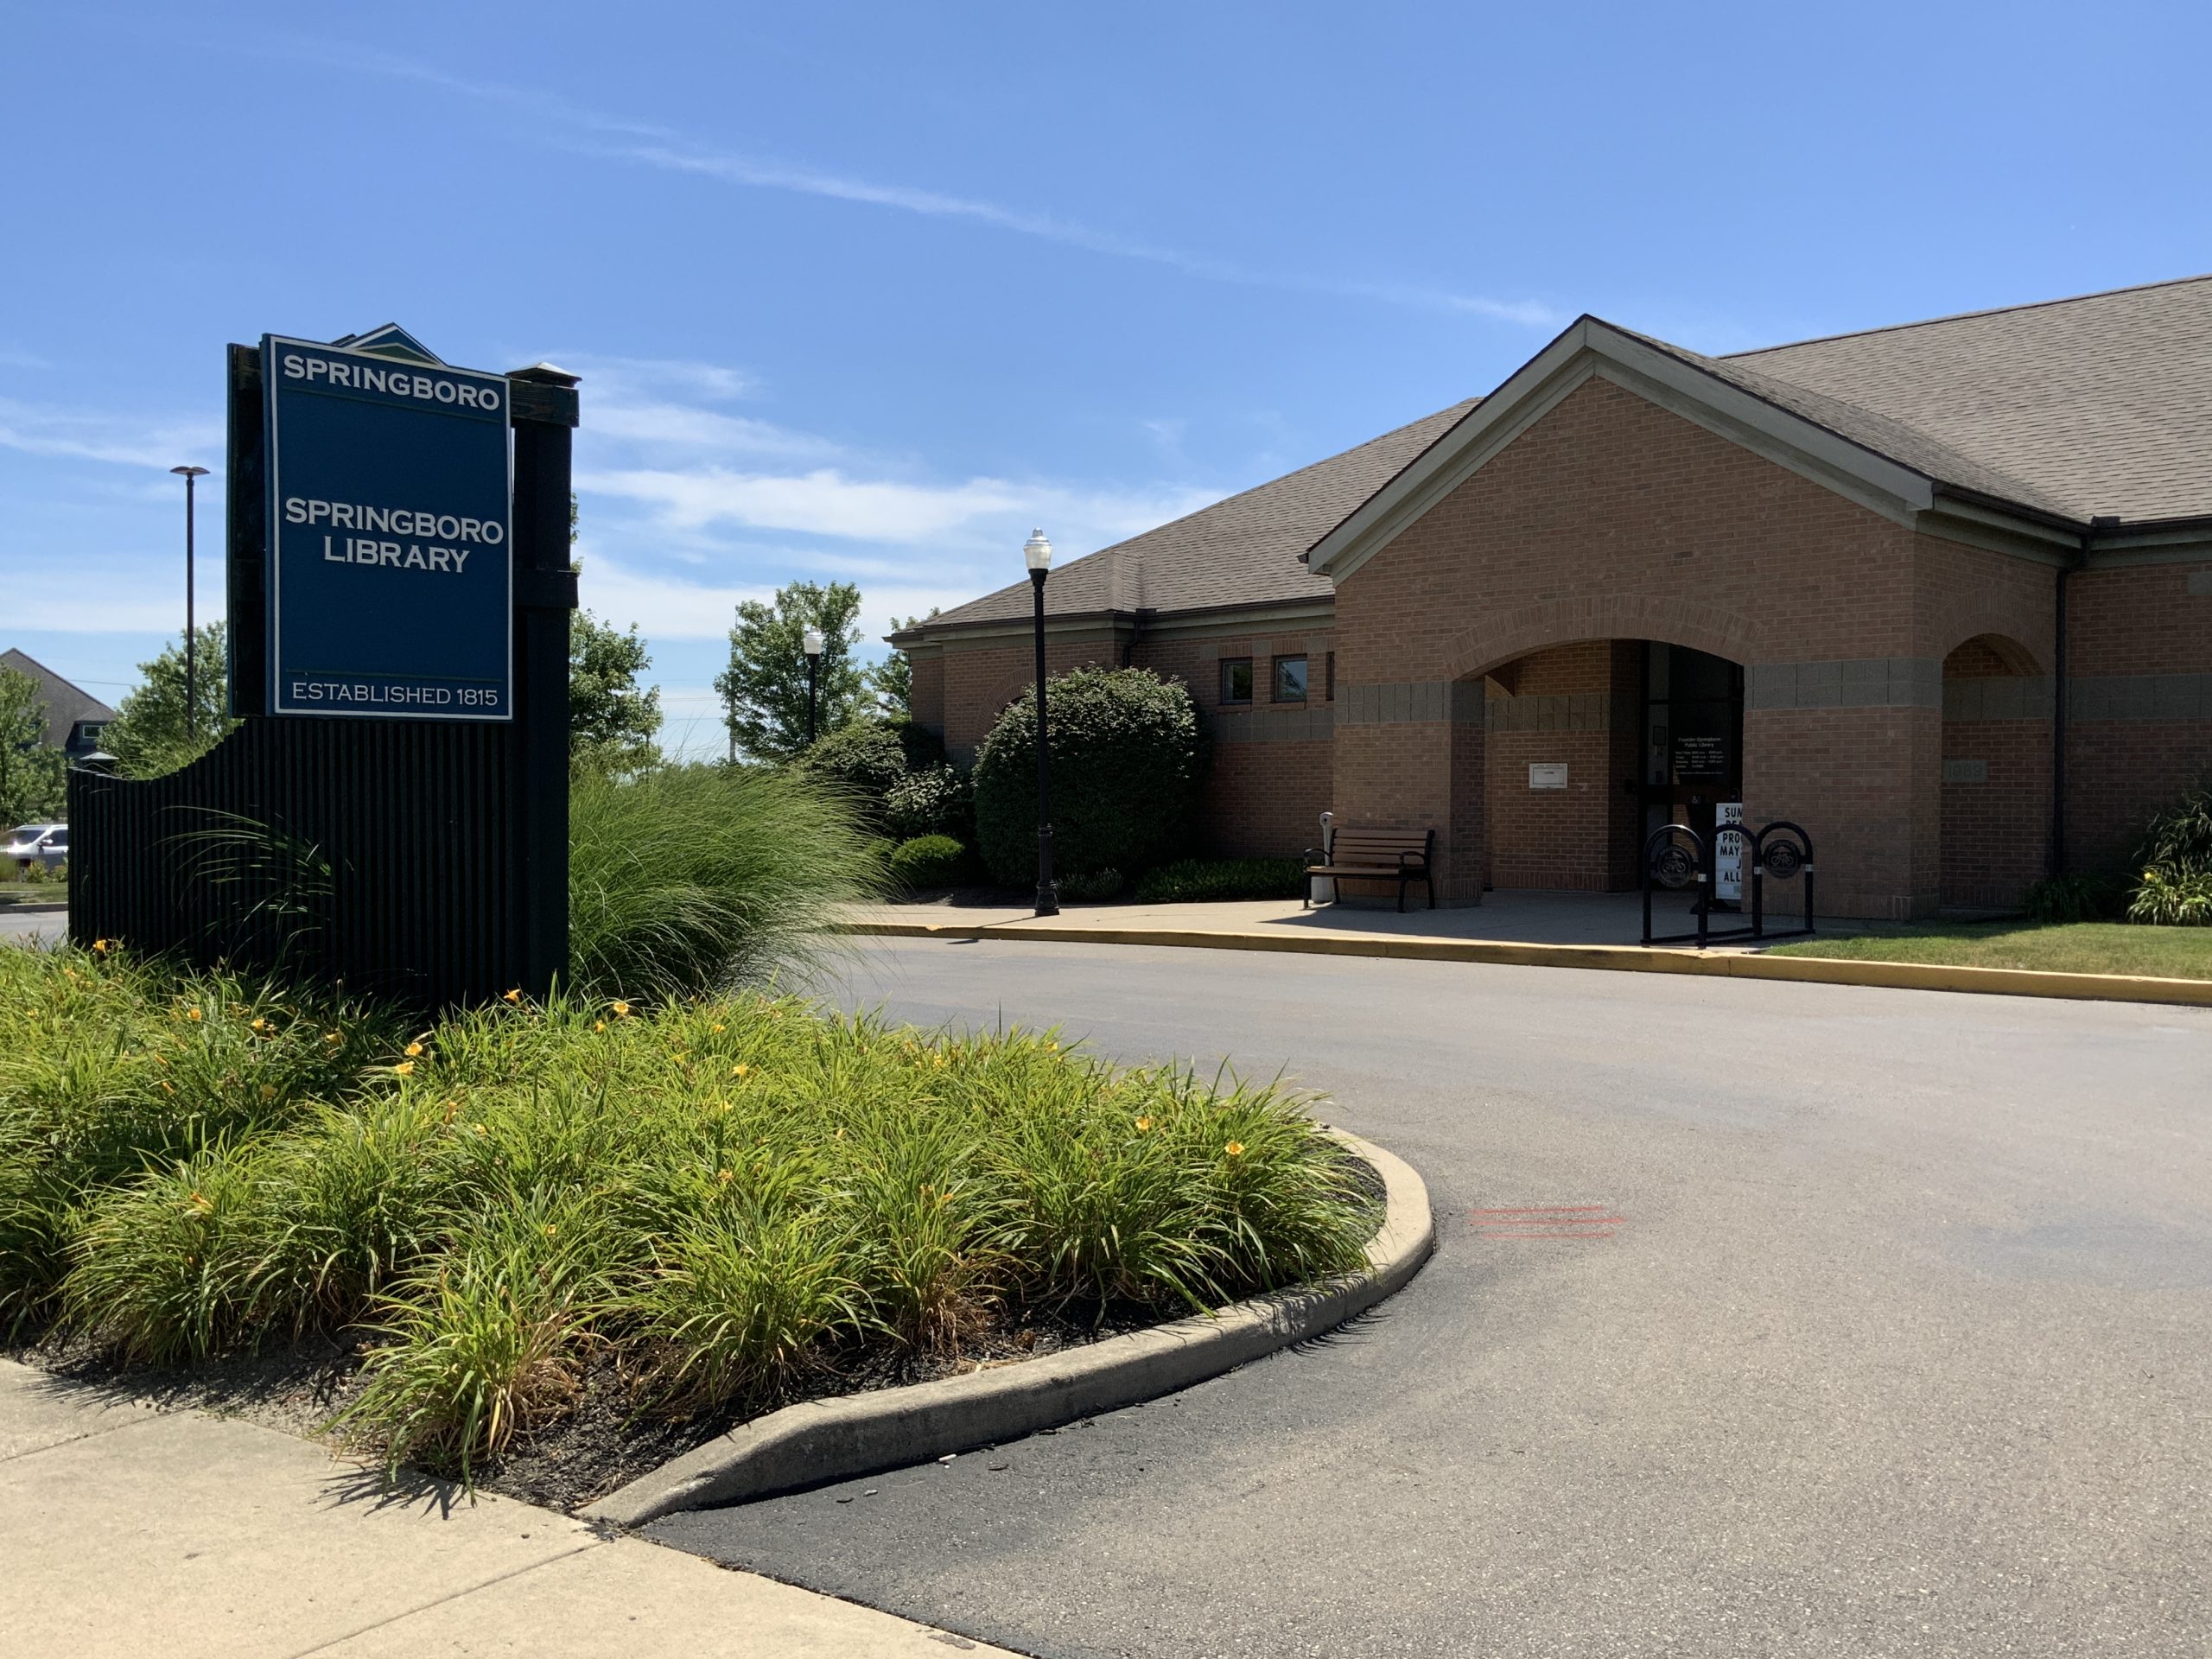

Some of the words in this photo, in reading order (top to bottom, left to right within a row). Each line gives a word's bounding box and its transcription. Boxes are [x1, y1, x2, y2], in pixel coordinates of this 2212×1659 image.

[283, 354, 500, 410] SPRINGBORO
[285, 498, 504, 544] SPRINGBORO
[324, 536, 471, 573] LIBRARY
[292, 682, 451, 704] ESTABLISHED
[456, 688, 498, 706] 1815
[1723, 832, 1743, 843] PRO
[1719, 845, 1739, 856] MAY
[1724, 870, 1741, 882] ALL
